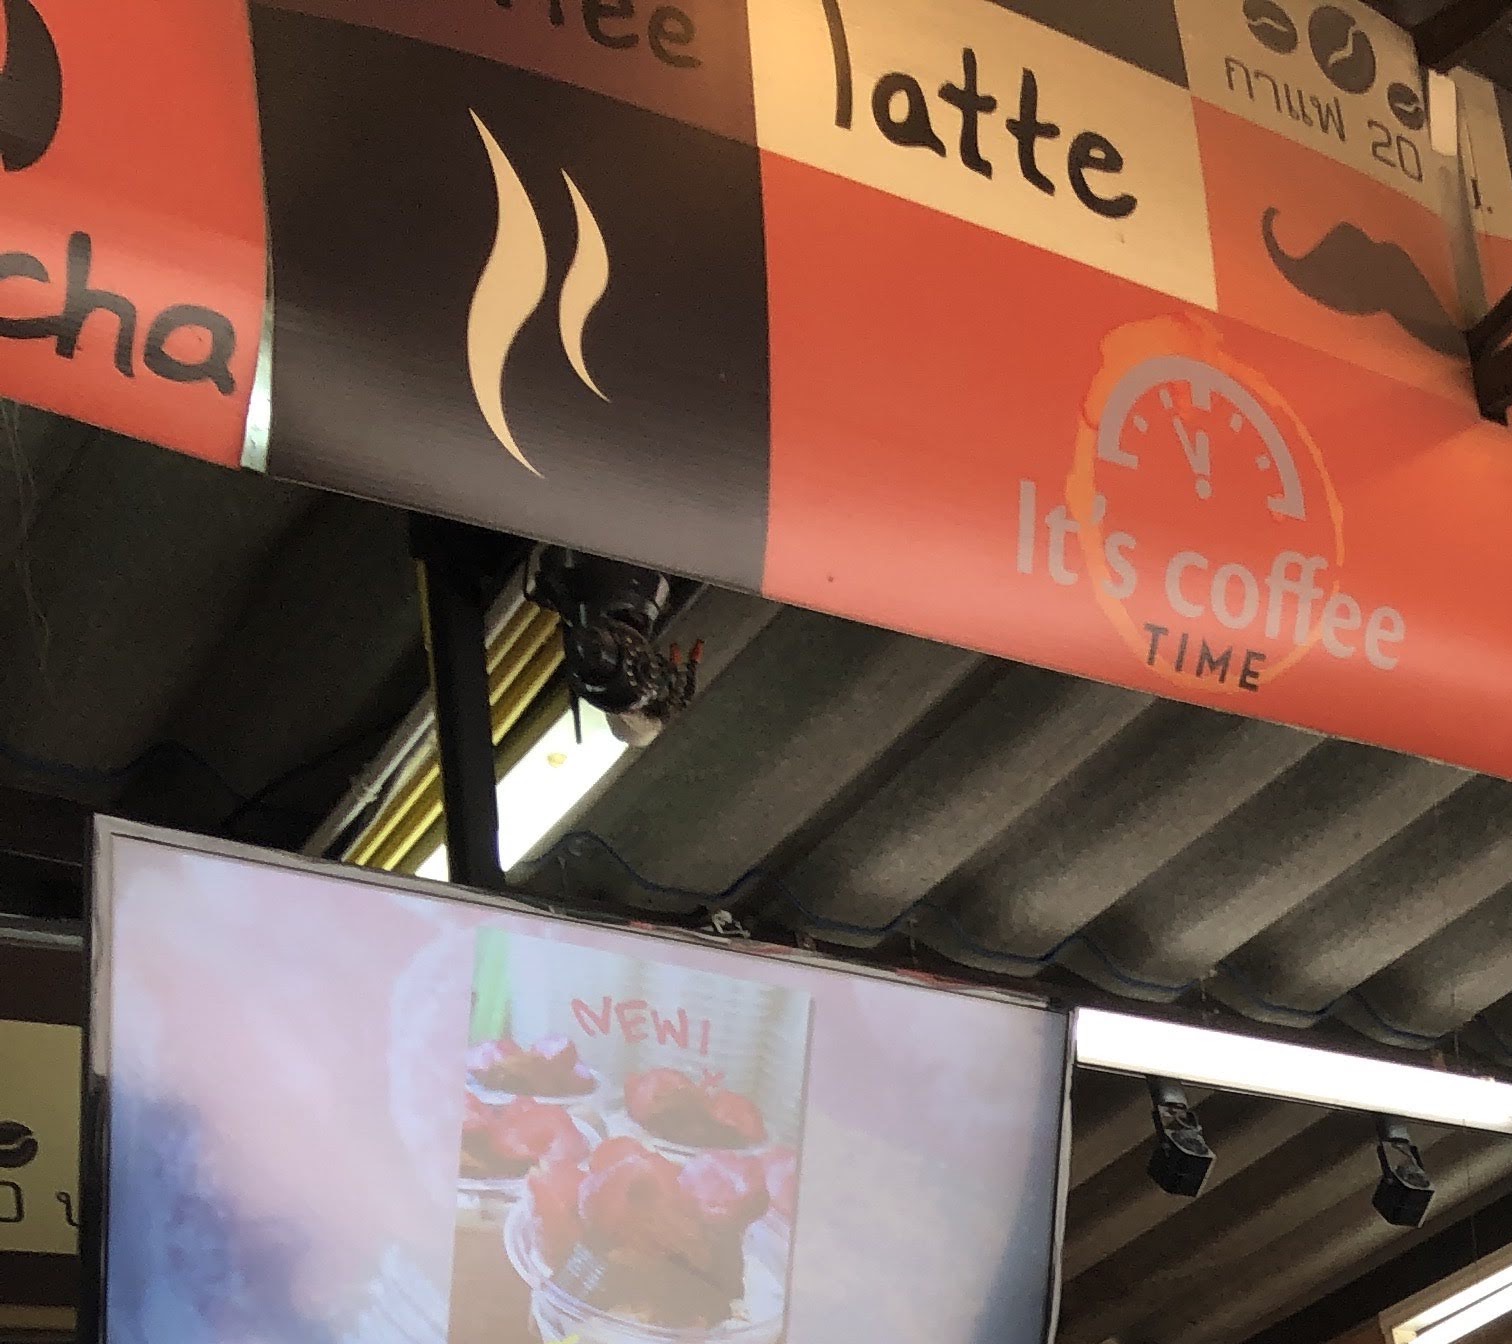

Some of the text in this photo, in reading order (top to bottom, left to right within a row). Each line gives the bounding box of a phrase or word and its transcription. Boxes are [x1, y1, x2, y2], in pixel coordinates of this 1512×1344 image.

[826, 0, 1137, 218] latte
[1015, 479, 1408, 671] It's coffee
[1142, 621, 1268, 693] TIME
